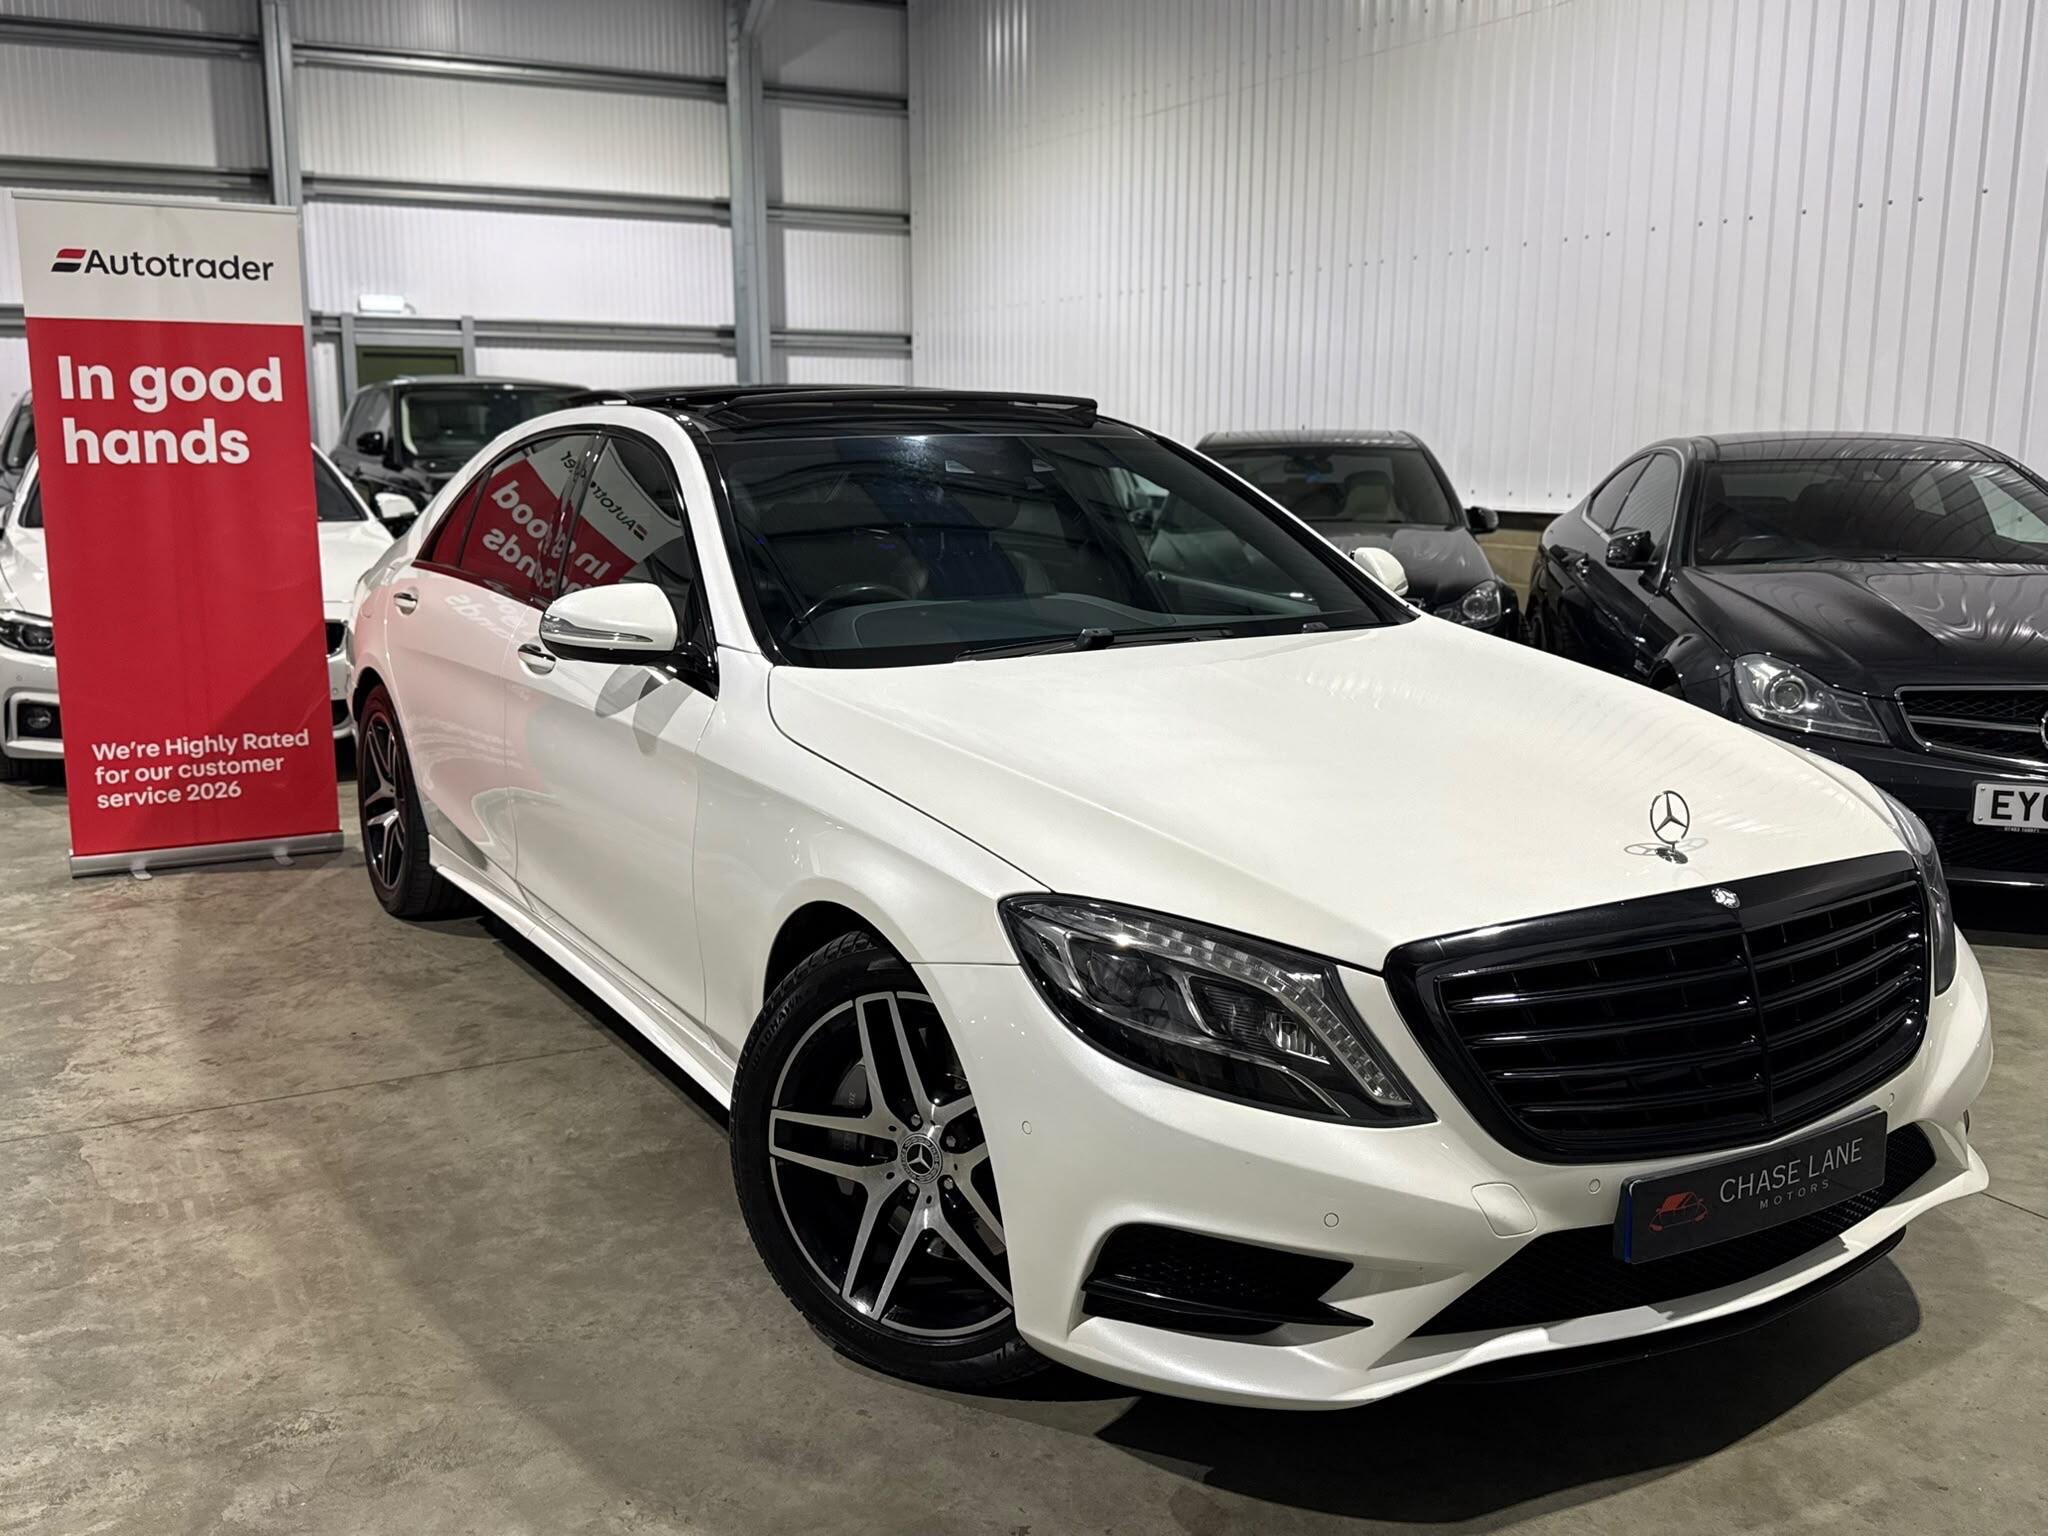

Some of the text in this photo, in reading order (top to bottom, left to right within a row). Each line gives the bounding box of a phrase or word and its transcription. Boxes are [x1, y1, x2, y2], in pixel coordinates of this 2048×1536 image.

[84, 249, 274, 281] Autotrader
[57, 355, 283, 414] In good
[62, 417, 250, 465] hands
[91, 728, 310, 761] We're Highly Rated
[94, 755, 285, 785] for our customer
[97, 780, 242, 809] service 2026
[1719, 1137, 1864, 1203] CHASE LANE
[1759, 1178, 1831, 1210] MOTORS
